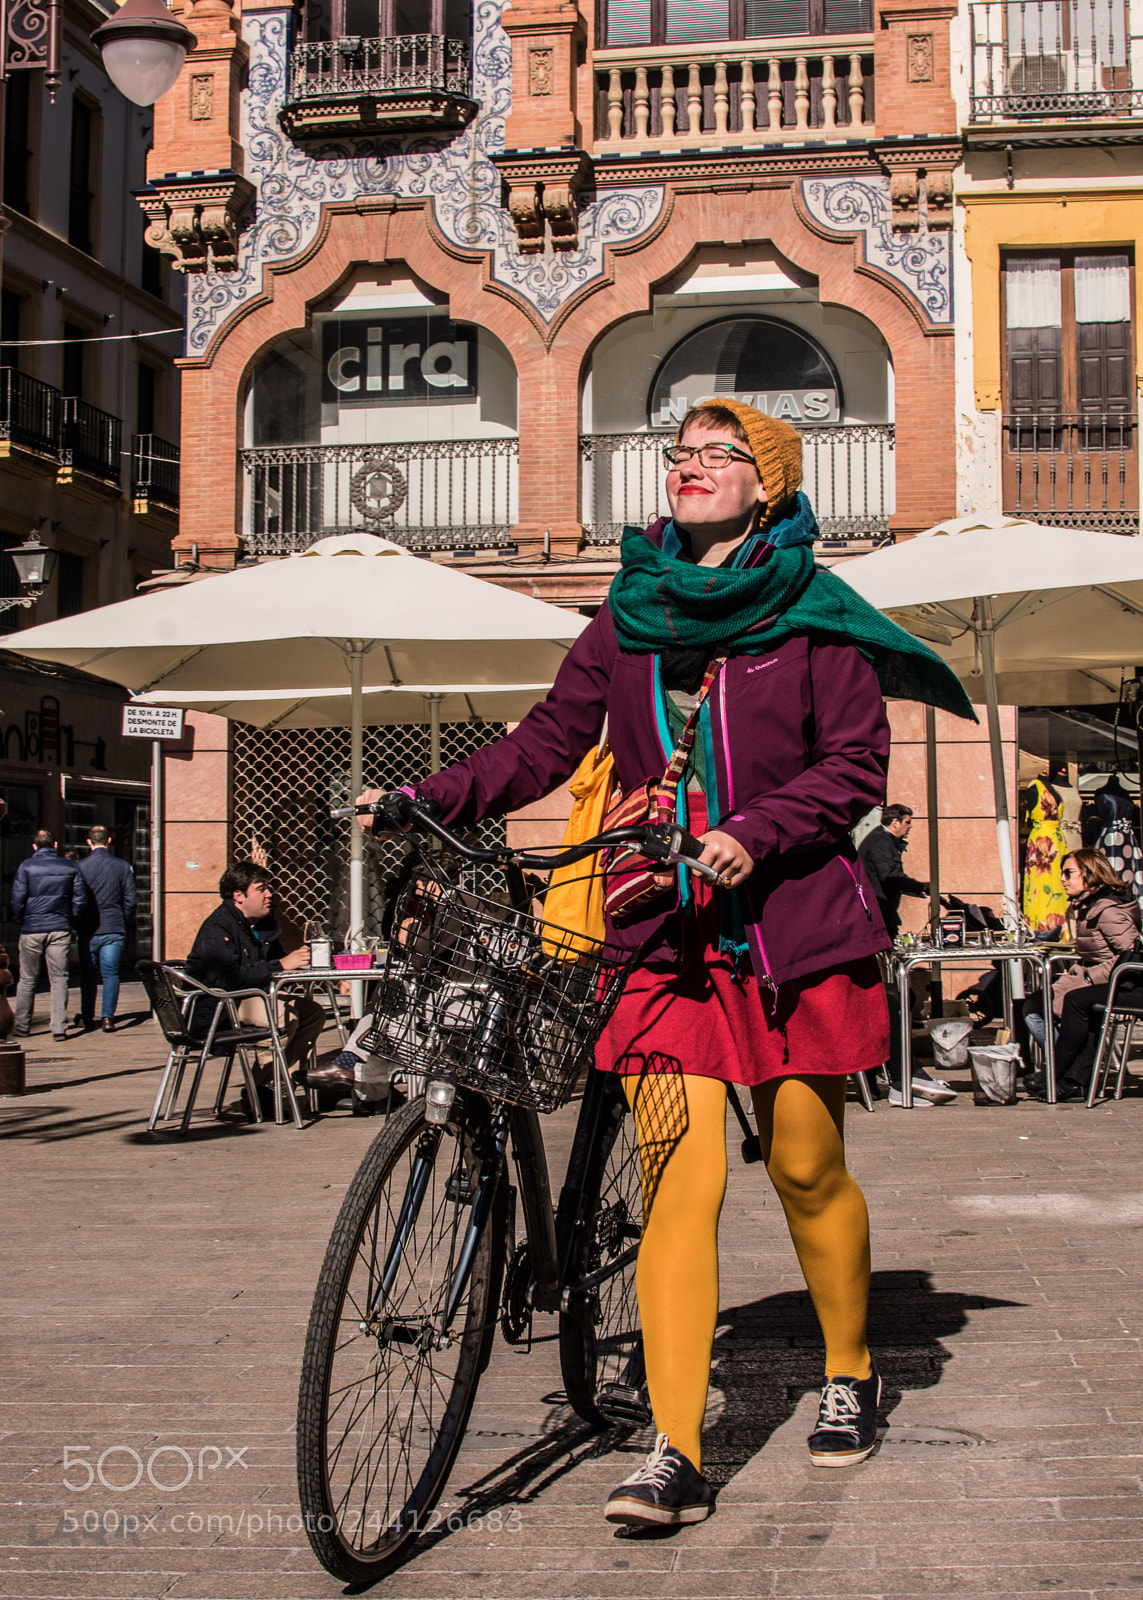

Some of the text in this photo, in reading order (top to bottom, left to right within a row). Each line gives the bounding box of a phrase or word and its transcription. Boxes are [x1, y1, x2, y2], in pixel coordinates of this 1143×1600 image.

[327, 327, 468, 392] cira
[660, 392, 830, 422] NIAS
[128, 718, 165, 726] DESMONTE
